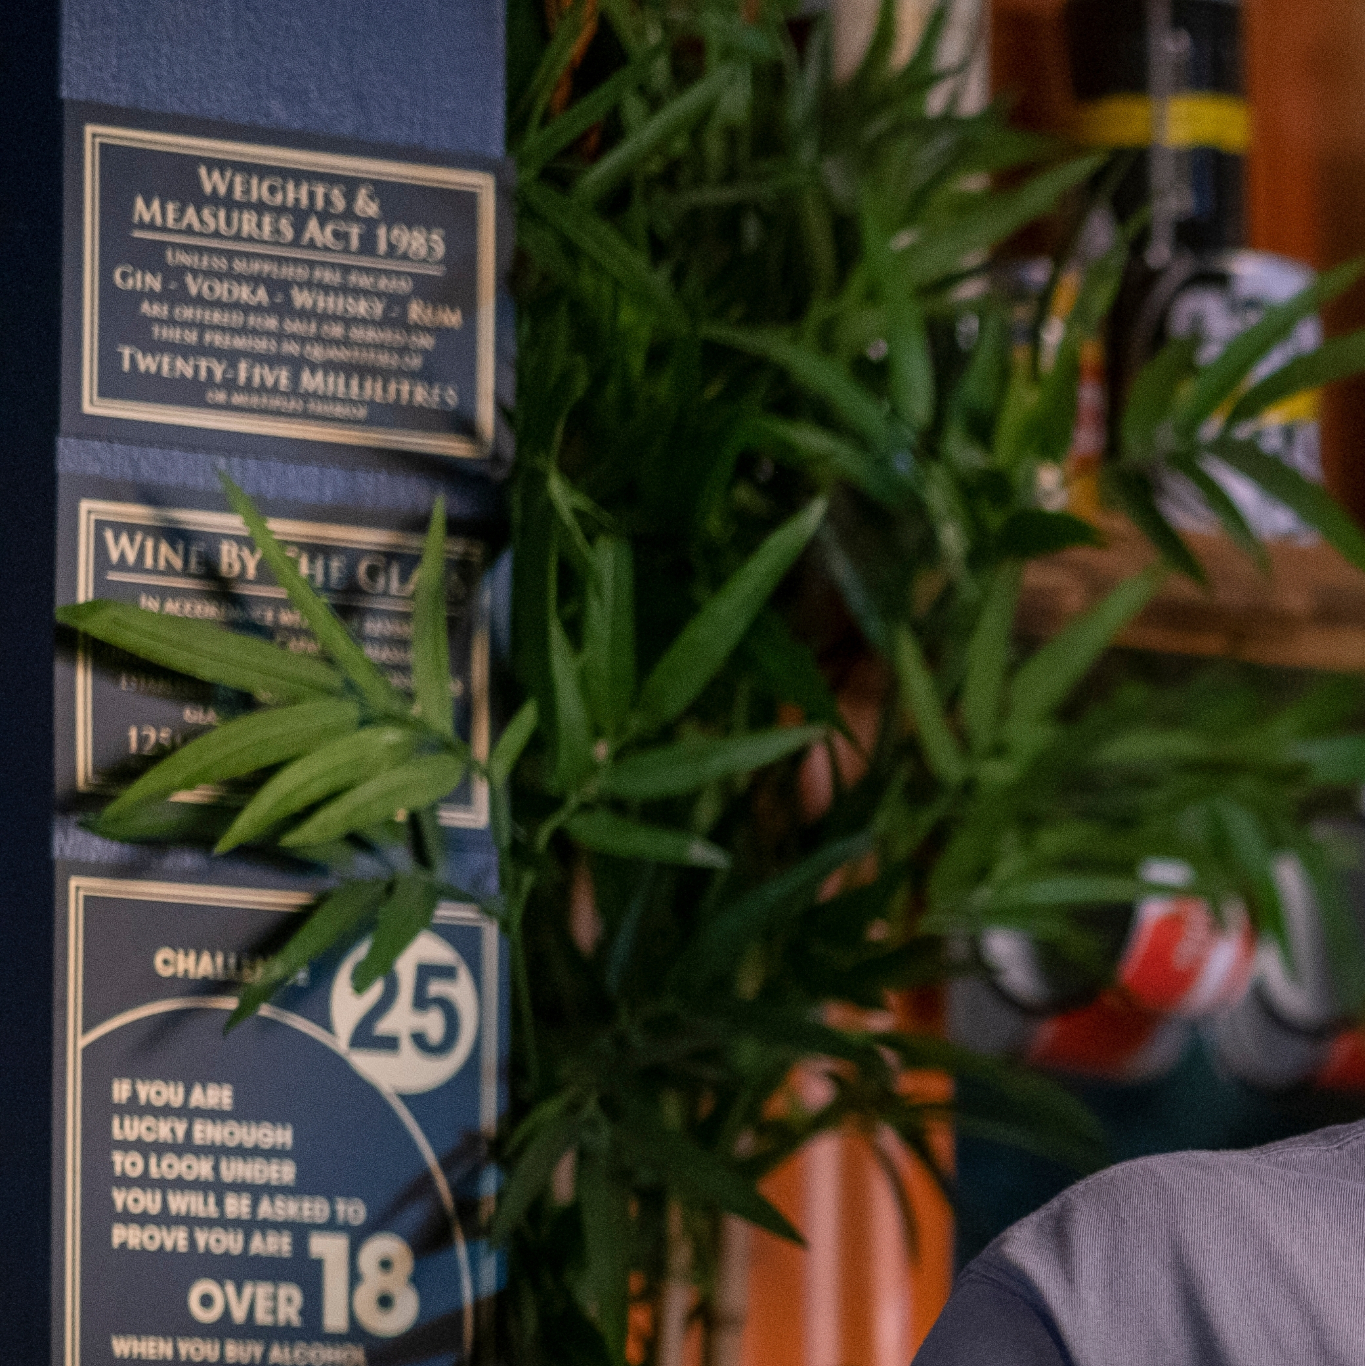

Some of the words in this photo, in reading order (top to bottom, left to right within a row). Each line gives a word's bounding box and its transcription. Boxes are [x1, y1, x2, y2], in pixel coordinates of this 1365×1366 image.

[198, 165, 347, 214] WEIGHTS
[355, 181, 380, 218] &
[133, 194, 293, 243] MEASURES
[302, 212, 363, 253] ACT
[376, 222, 446, 262] 1985
[114, 263, 161, 298] GIN
[185, 271, 268, 309] VODKA
[291, 282, 384, 321] WHISKY
[407, 294, 462, 329] RUM
[118, 345, 290, 392] TWENTY-FIVE
[299, 365, 459, 411] MILLILITRES
[104, 528, 207, 576] WINE
[220, 539, 263, 582] BY
[349, 963, 460, 1056] 25
[113, 1078, 130, 1105] IF
[137, 1079, 183, 1108] YOU
[190, 1082, 232, 1110] ARE
[113, 1115, 185, 1145] LUCKY
[193, 1118, 292, 1149] ENOUGH
[113, 1151, 143, 1179] TO
[150, 1153, 213, 1182] LOOK
[220, 1156, 295, 1186] UNDER
[113, 1188, 161, 1216] YOU
[168, 1190, 218, 1219] WILL
[225, 1193, 251, 1220] BE
[258, 1194, 329, 1224] ASKED
[336, 1198, 365, 1226] TO
[113, 1223, 188, 1253] PROVE
[195, 1227, 243, 1256] YOU
[250, 1230, 291, 1258] ARE
[187, 1278, 304, 1328] OVER
[308, 1231, 420, 1338] 18
[112, 1334, 171, 1363] WHEN
[178, 1336, 218, 1364] YOU
[225, 1338, 261, 1366] BUY
